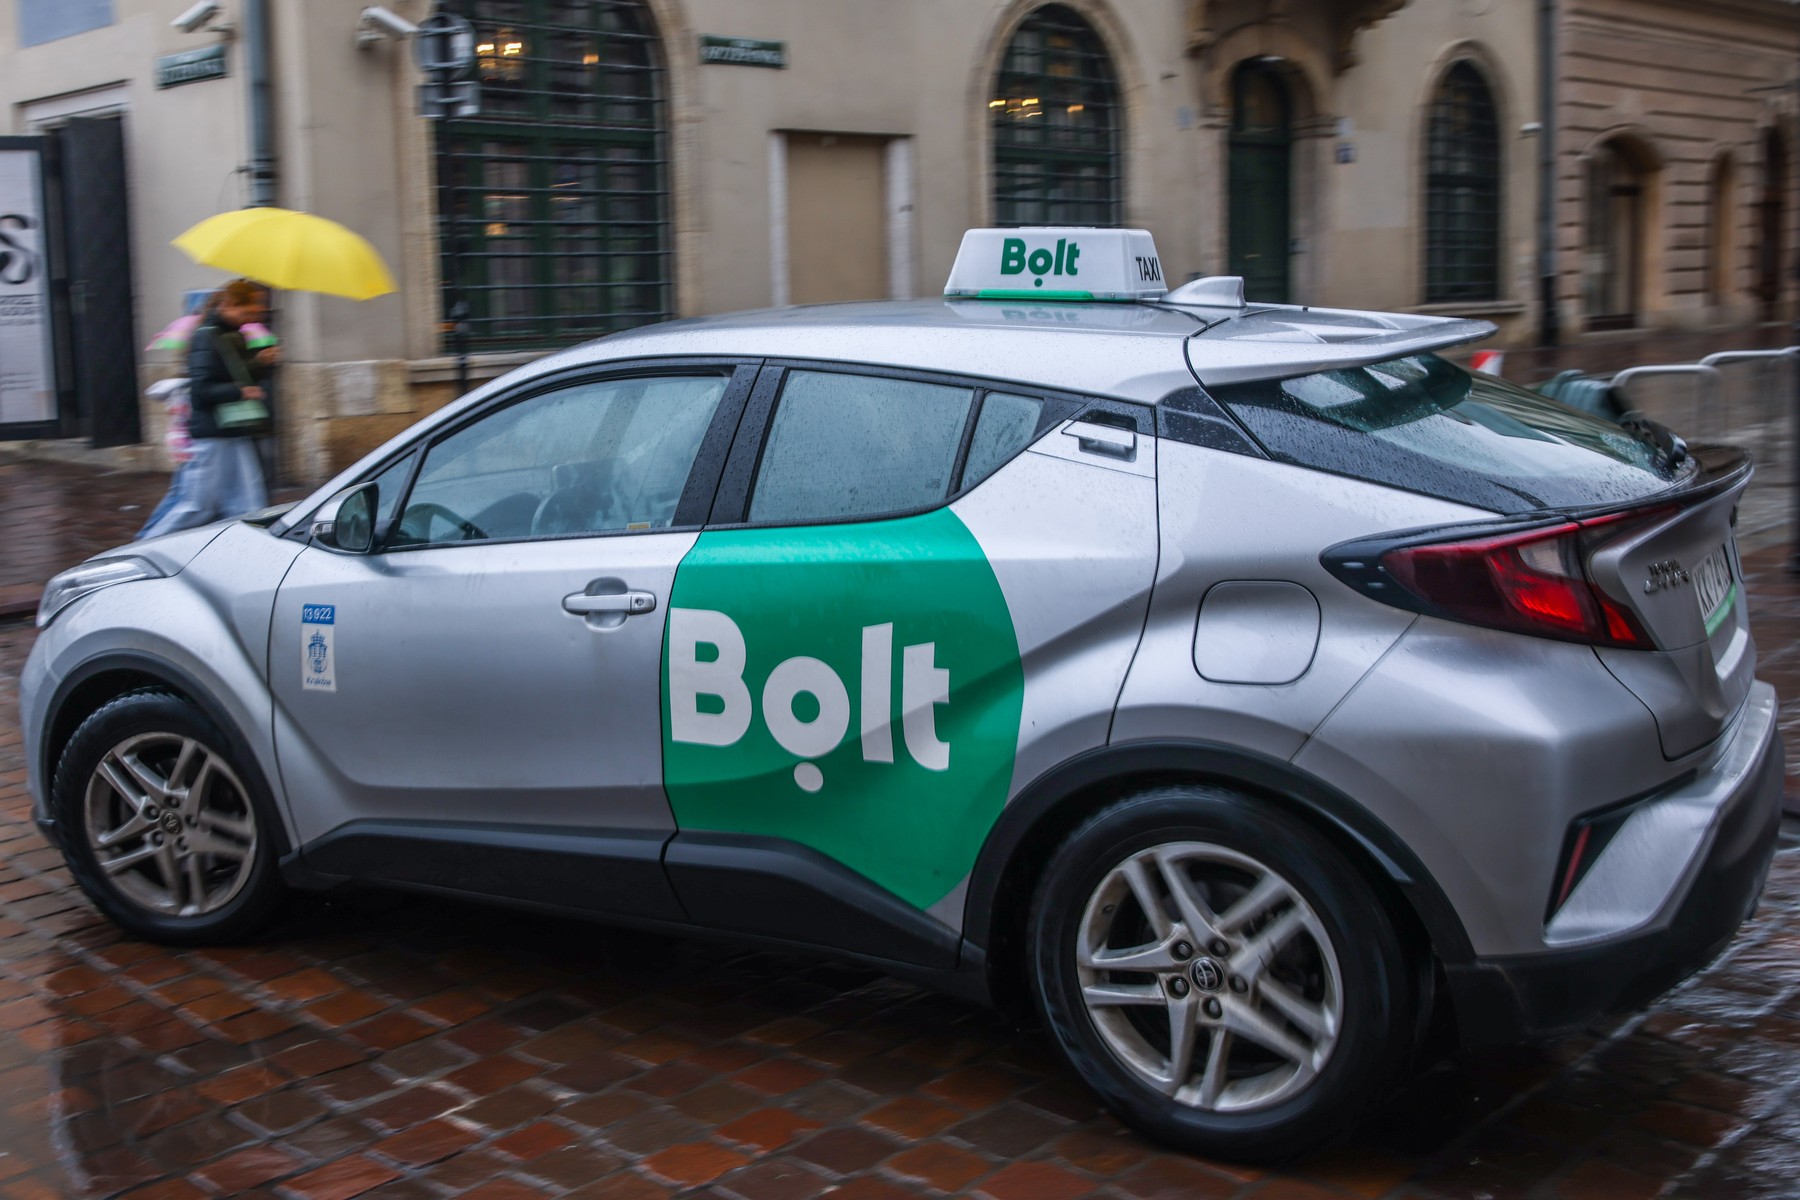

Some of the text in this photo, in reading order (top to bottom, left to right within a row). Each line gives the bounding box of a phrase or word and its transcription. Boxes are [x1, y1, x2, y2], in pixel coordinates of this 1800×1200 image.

[1001, 238, 1080, 287] Bolt
[1135, 256, 1161, 282] TAXI
[669, 607, 949, 792] Bolt
